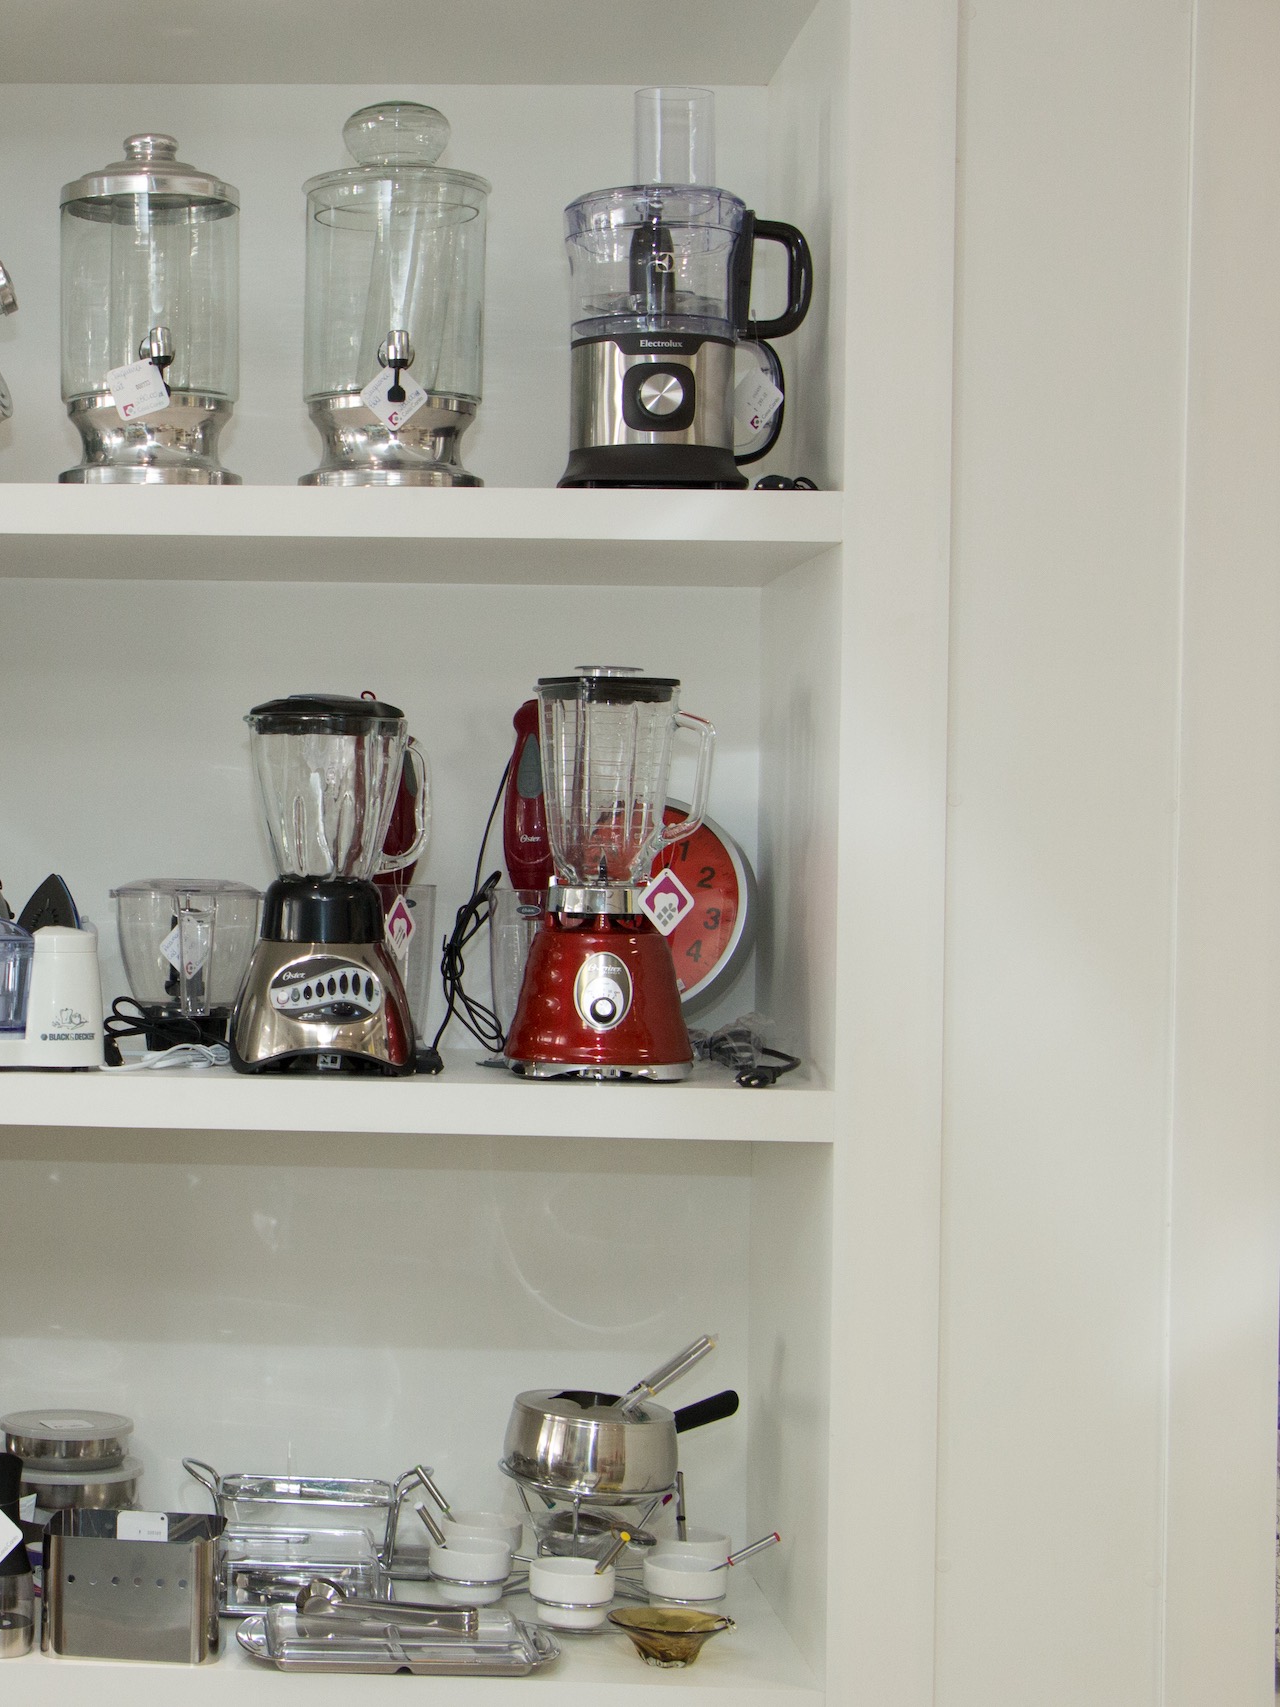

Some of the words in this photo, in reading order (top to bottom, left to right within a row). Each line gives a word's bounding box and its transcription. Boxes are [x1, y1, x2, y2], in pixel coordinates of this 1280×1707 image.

[639, 339, 683, 348] Electrolux
[520, 834, 541, 843] Oster
[678, 840, 691, 862] 1
[697, 866, 716, 889] 2
[703, 907, 721, 931] 3
[686, 939, 703, 963] 4
[282, 971, 306, 982] Oster
[49, 1033, 95, 1041] BLACK&DECKER
